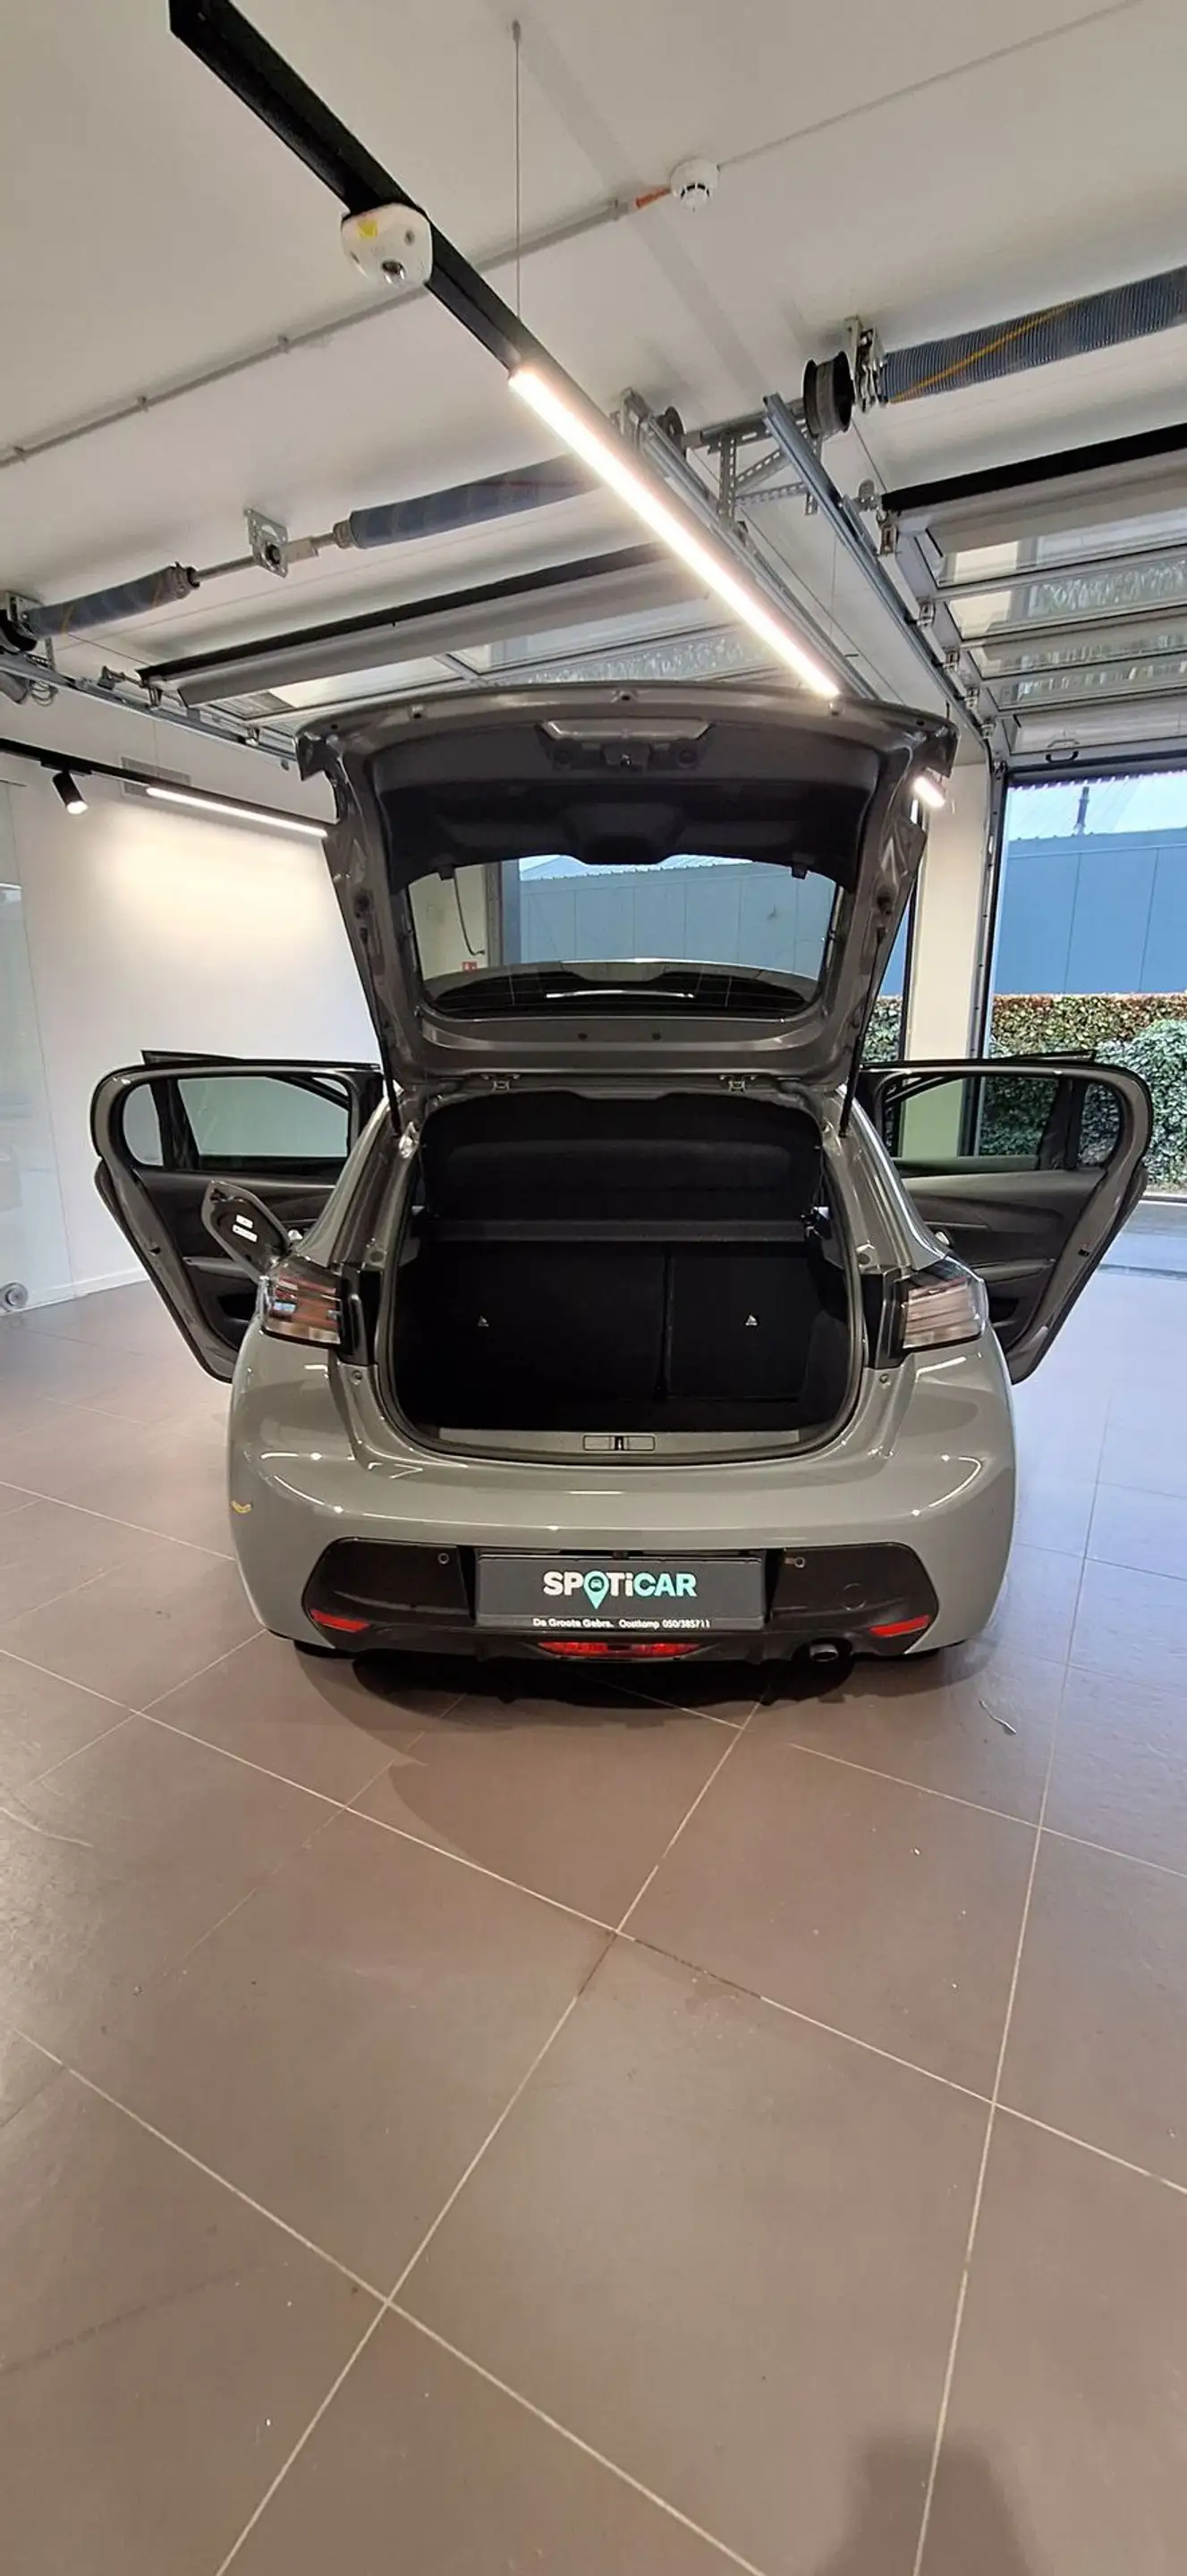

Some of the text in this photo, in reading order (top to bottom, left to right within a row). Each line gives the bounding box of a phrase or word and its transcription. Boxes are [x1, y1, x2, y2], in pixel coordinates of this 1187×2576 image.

[532, 1618, 547, 1627] De
[547, 1618, 581, 1627] Groote
[618, 1619, 659, 1630] Oostkamp
